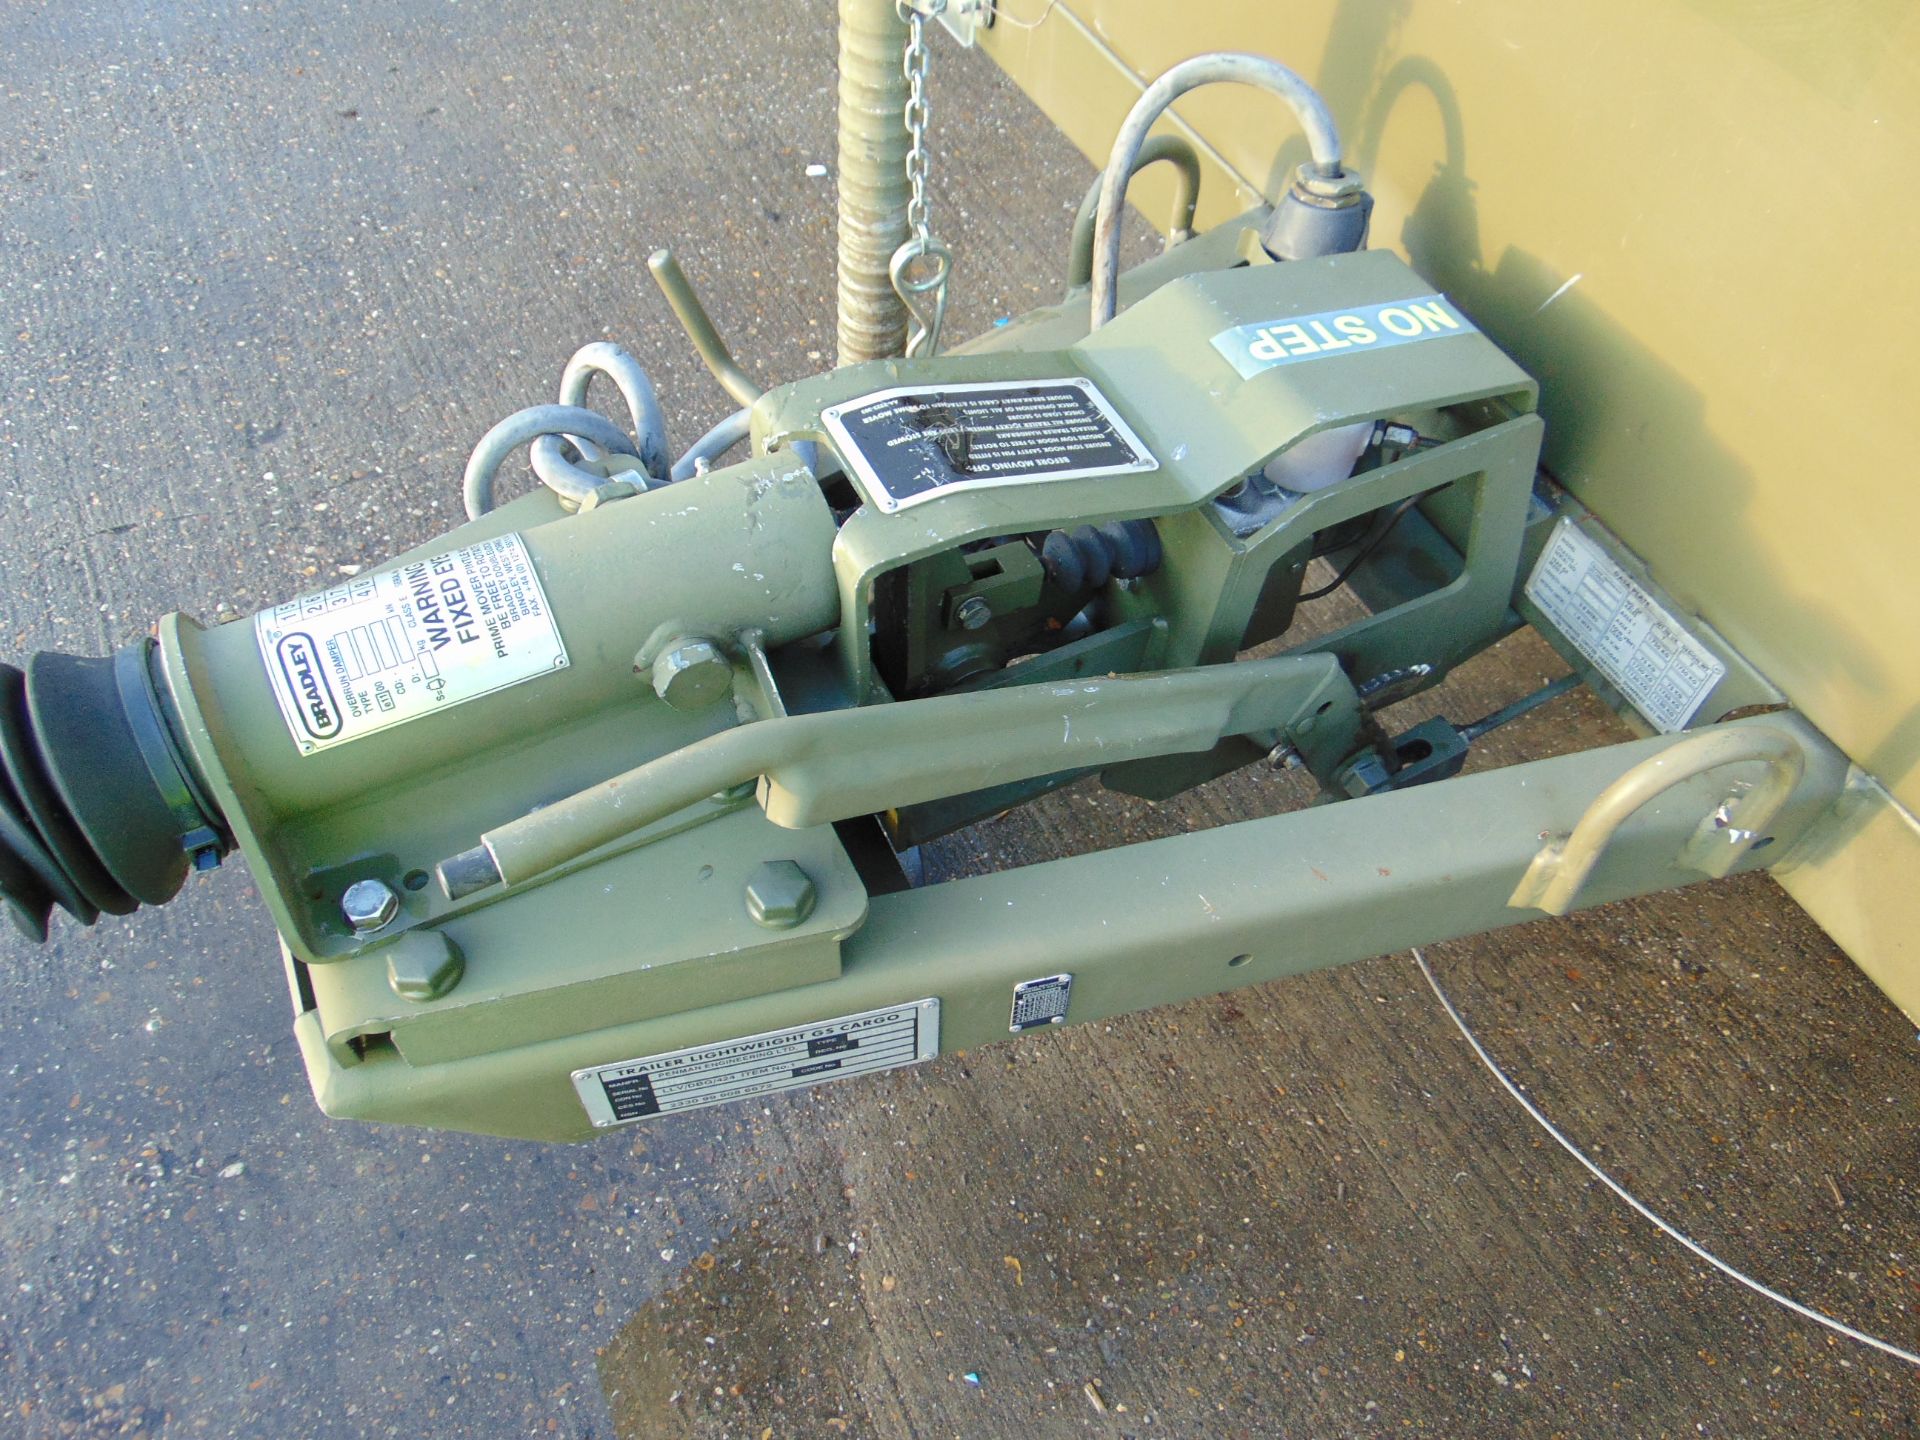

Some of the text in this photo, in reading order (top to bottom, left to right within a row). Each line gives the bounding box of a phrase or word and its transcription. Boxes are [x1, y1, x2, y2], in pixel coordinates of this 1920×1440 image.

[1248, 301, 1460, 361] NO STEP
[861, 410, 893, 423] MOVER
[885, 432, 922, 446] STOWED
[995, 430, 1042, 438] HANDBRAKE
[990, 459, 1035, 469] MOVING
[1033, 456, 1071, 465] BEFORE
[458, 550, 476, 575] PINTLE
[499, 553, 514, 574] WEST
[514, 562, 525, 574] (0)
[478, 565, 492, 578] TO
[354, 580, 370, 588] 8
[519, 575, 533, 593] +44
[329, 587, 344, 595] 7
[356, 589, 371, 598] 4
[467, 575, 492, 615] MOVER
[484, 579, 504, 610] FREE
[304, 595, 321, 603] 6
[331, 596, 348, 606] 3
[429, 553, 480, 644] FIXED EYE
[497, 578, 521, 622] BRADLEY
[279, 603, 295, 611] 5
[306, 604, 322, 613] 2
[384, 602, 394, 613] kN
[403, 561, 453, 650] WARNING
[401, 602, 417, 628] CLASS
[496, 611, 512, 629] BE
[415, 638, 427, 650] kg
[484, 617, 508, 658] PRIME
[287, 639, 331, 729] BRADLEY
[324, 638, 362, 718] OVERRUN DAMPER
[410, 673, 420, 683] D:
[373, 680, 385, 691] 00
[393, 678, 406, 695] CD:
[358, 690, 373, 713] TYPE
[616, 1013, 899, 1076] TRAILER LIGHTWEIGHT GS CARGO
[816, 1037, 836, 1045] TYPE
[657, 1045, 797, 1078] PENMAN ENGINEERING LTD.
[740, 1068, 768, 1077] ITEM
[611, 1088, 637, 1096] SERIAL
